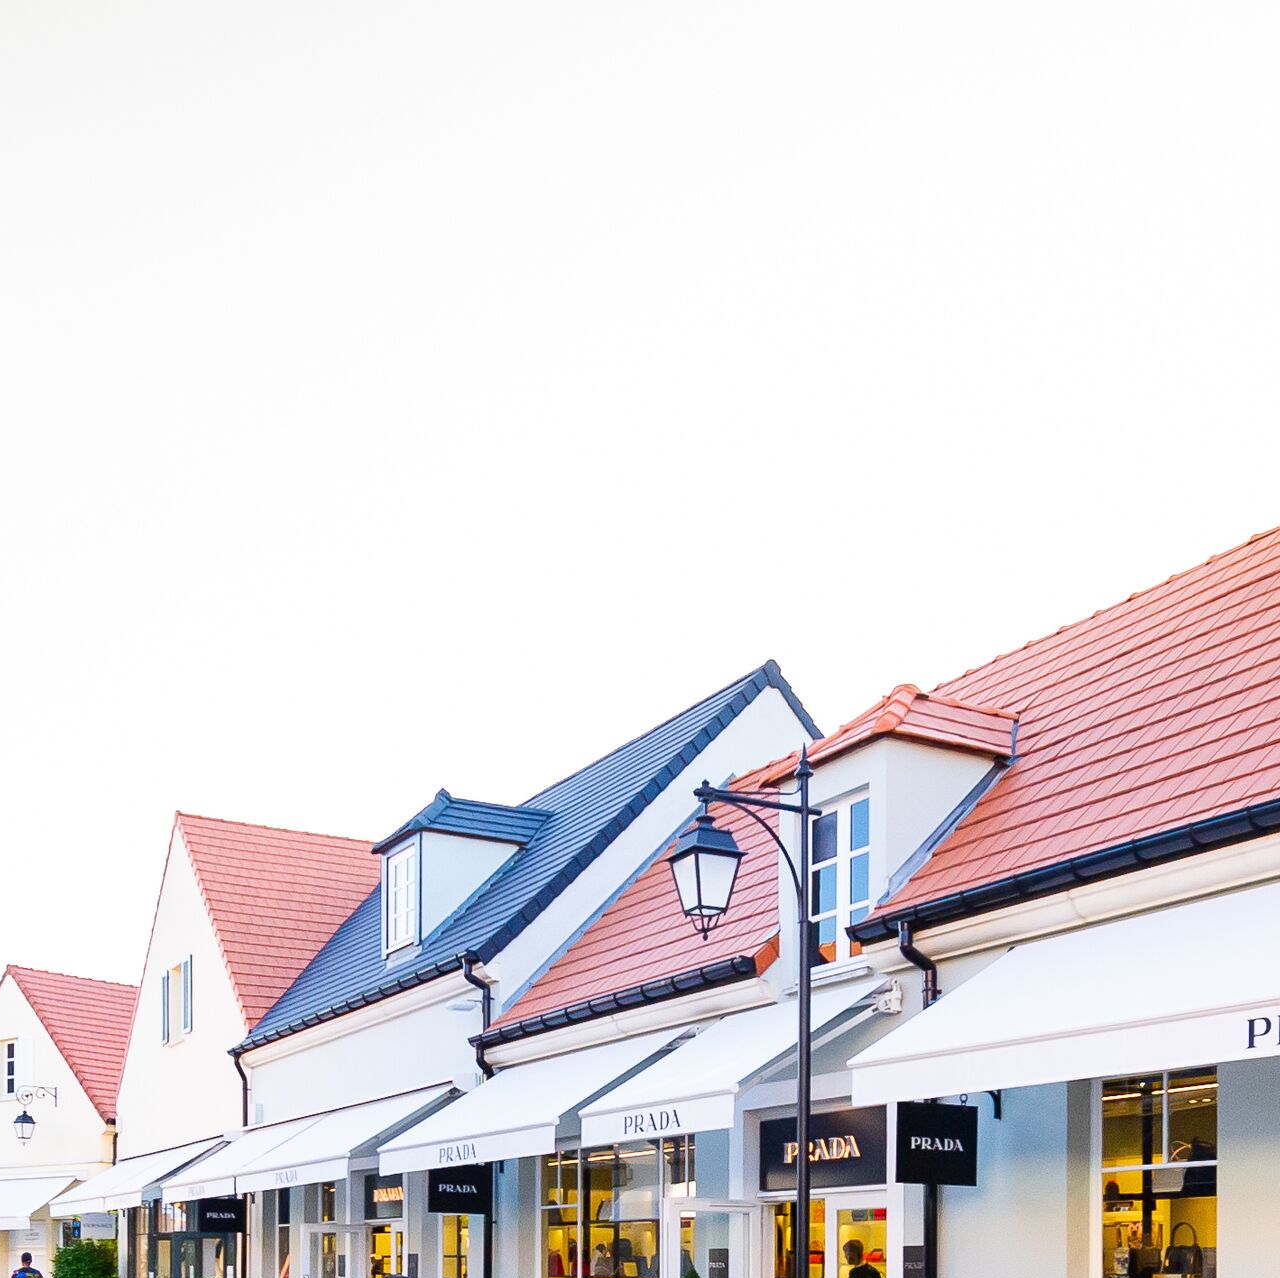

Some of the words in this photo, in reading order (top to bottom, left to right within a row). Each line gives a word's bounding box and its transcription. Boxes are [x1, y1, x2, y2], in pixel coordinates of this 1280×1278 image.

[623, 1109, 681, 1134] PRADA
[910, 1136, 964, 1152] PRADA
[438, 1143, 477, 1164] PRADA
[438, 1183, 478, 1195] PRADA
[206, 1211, 236, 1220] PRADA
